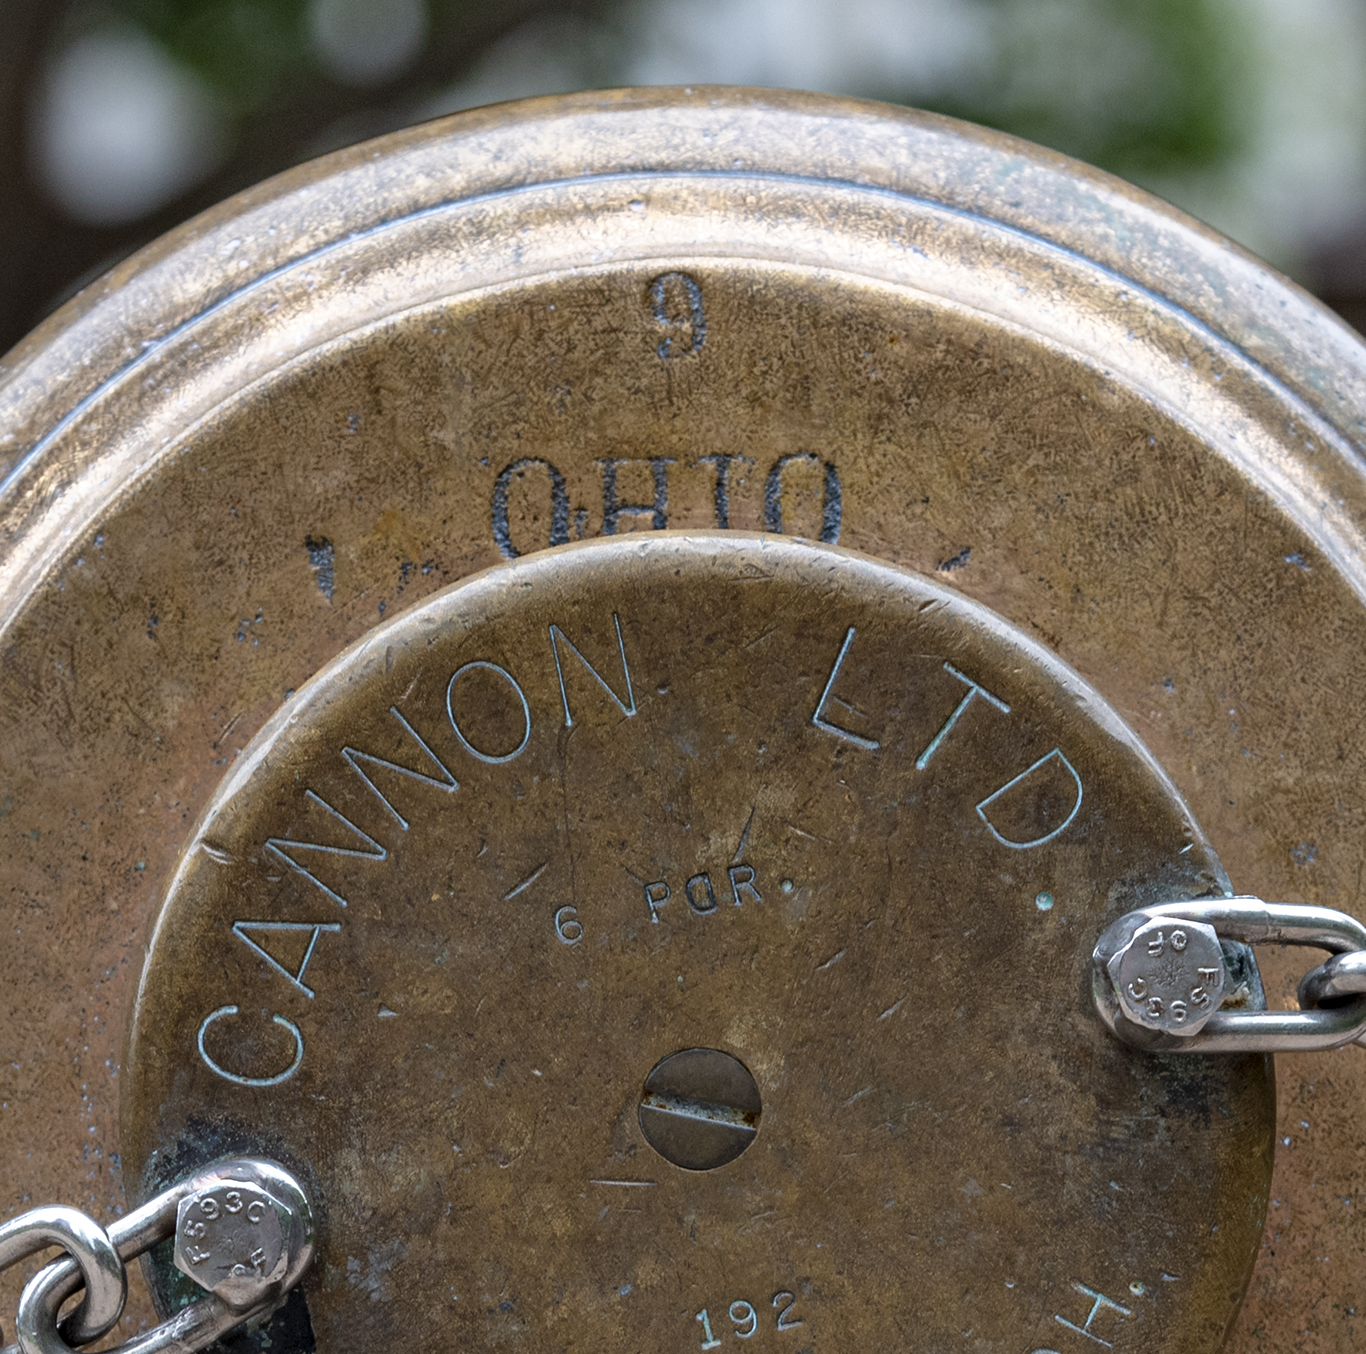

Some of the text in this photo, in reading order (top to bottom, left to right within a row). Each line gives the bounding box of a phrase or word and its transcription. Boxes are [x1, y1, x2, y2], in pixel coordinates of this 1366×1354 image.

[647, 271, 707, 359] 9
[491, 452, 843, 560] OHIO
[196, 611, 637, 1089] CANNON
[554, 905, 584, 945] 6
[1128, 967, 1219, 1023] F593C
[184, 1191, 267, 1266] F593C
[695, 1290, 803, 1350] 192
